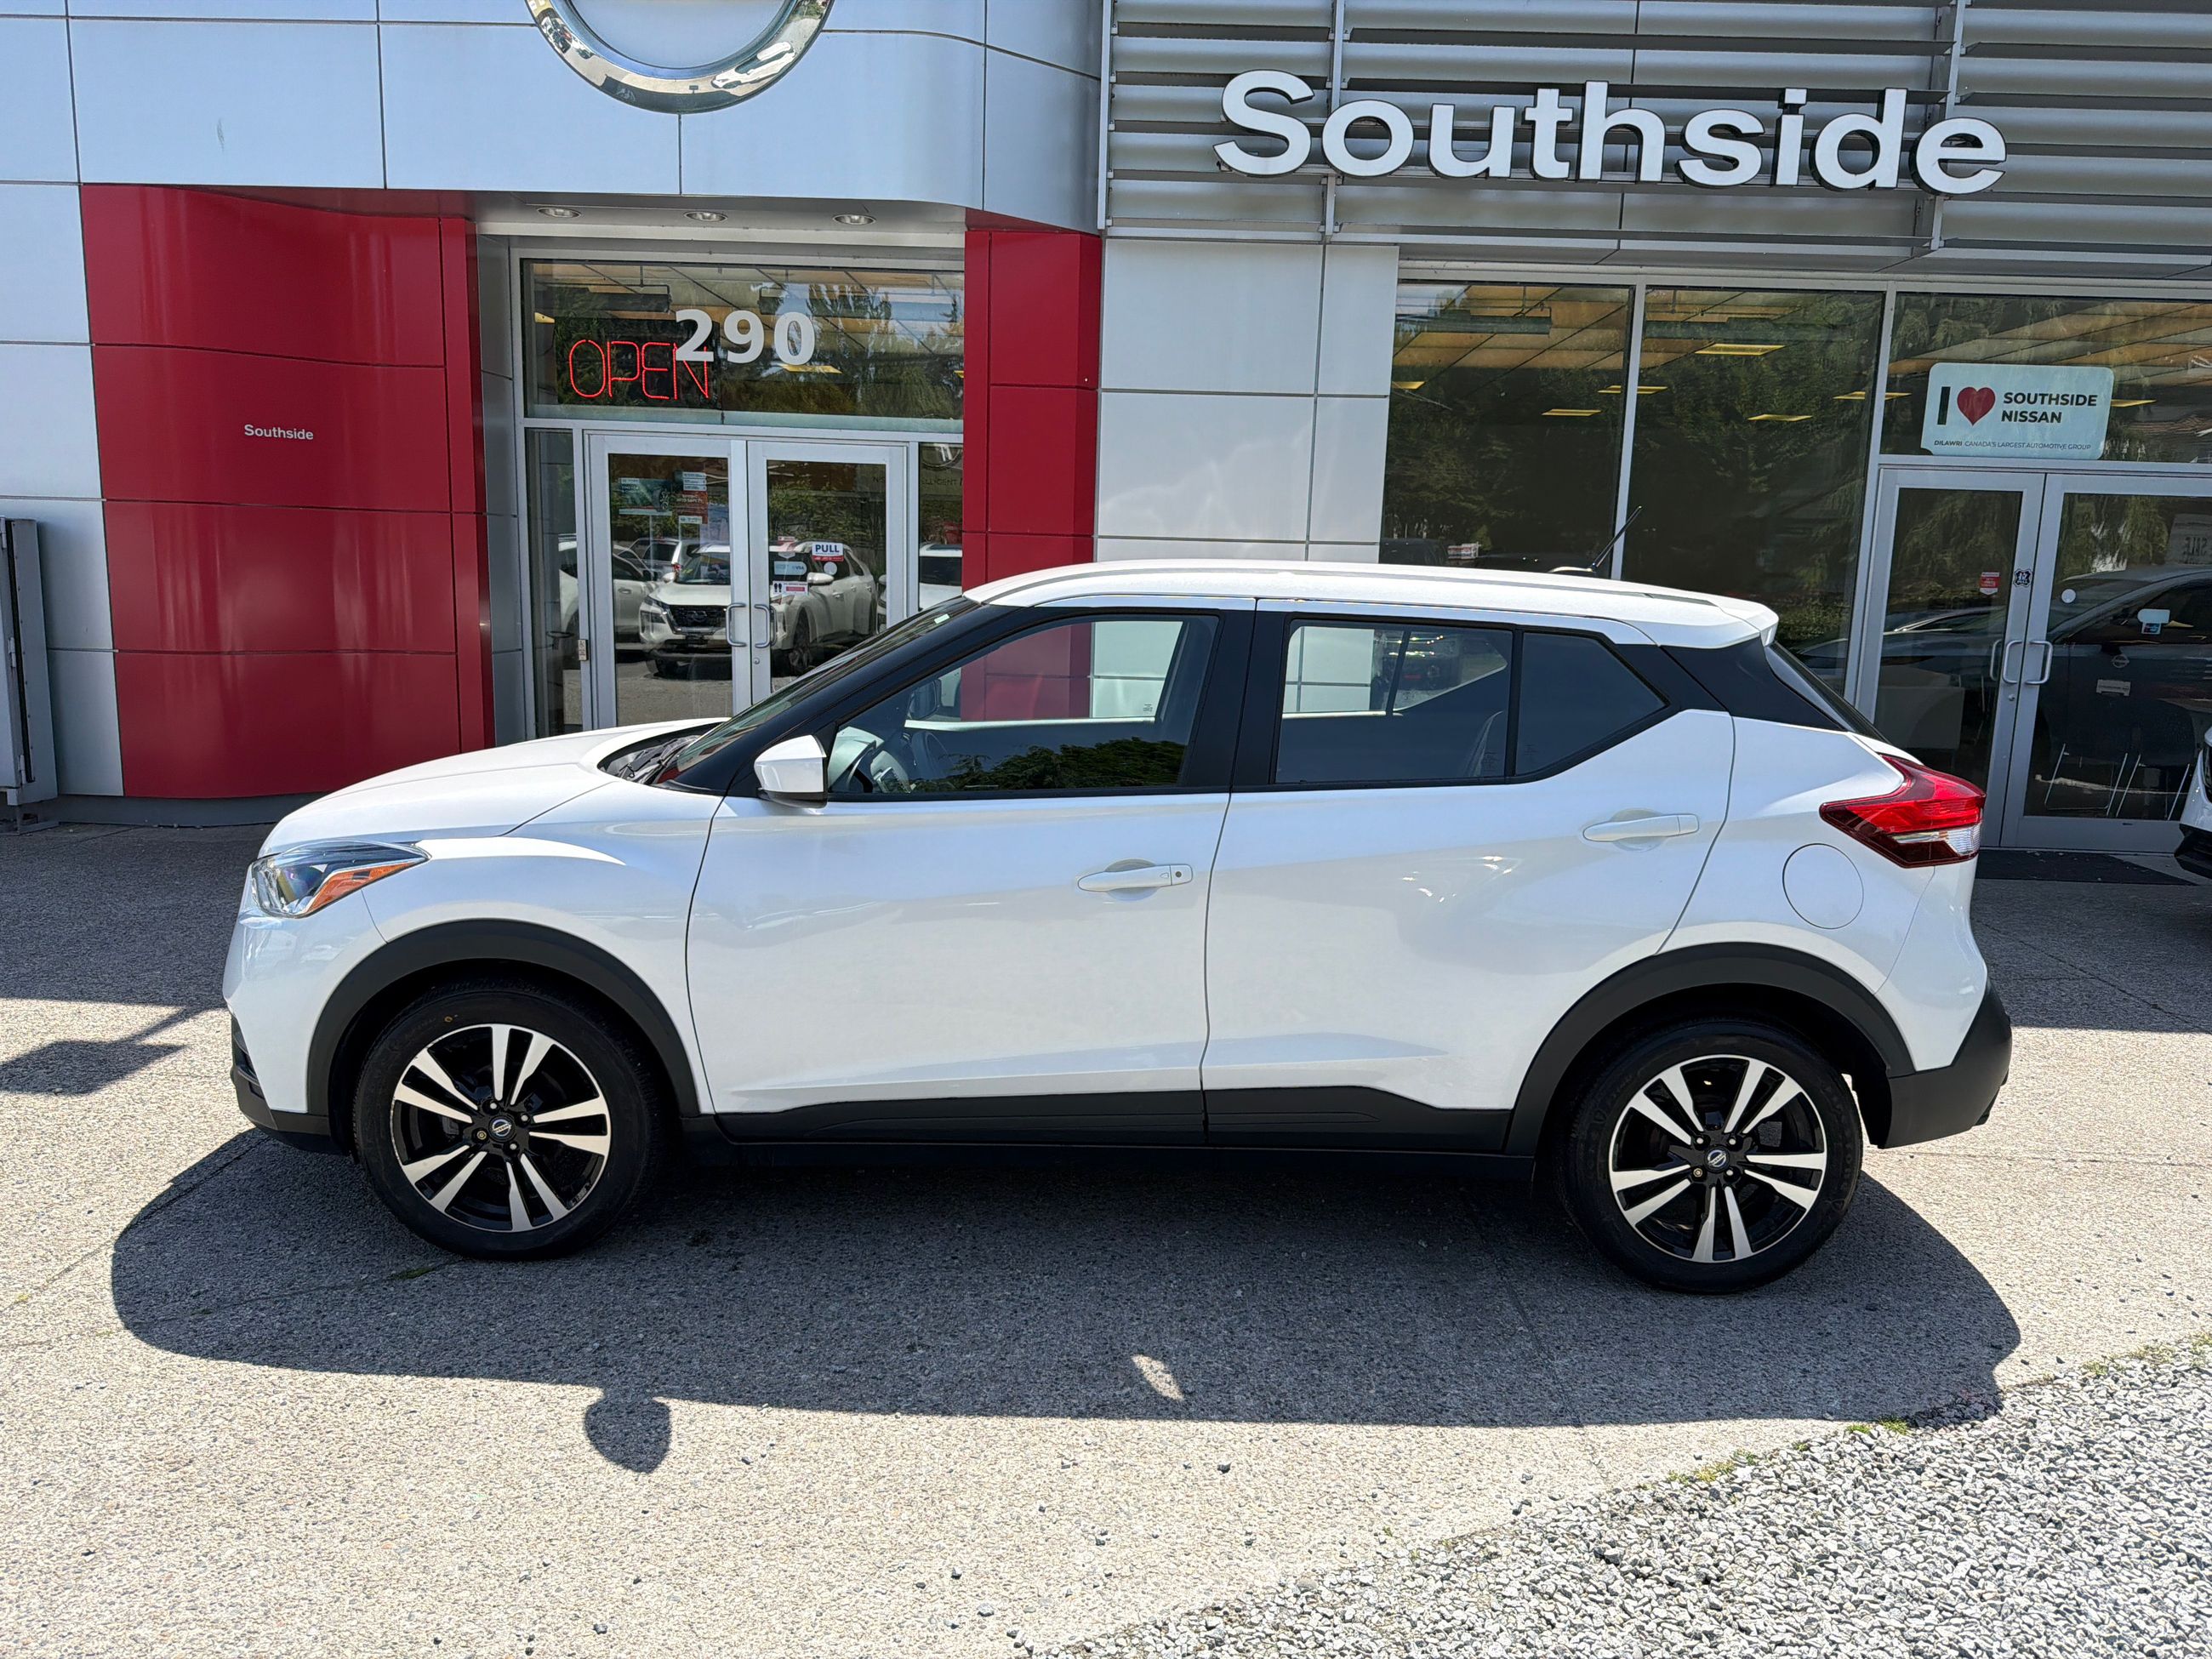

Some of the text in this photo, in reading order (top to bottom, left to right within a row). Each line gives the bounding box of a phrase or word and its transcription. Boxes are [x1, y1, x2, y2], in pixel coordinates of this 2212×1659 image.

[1211, 68, 2007, 197] Southside
[675, 308, 816, 366] 290
[568, 339, 710, 401] OPEN
[1936, 386, 1951, 425] I
[2003, 391, 2098, 407] SOUTHSIDE
[2001, 410, 2062, 424] NISSAN
[244, 424, 314, 440] Southside
[815, 544, 840, 553] PULL
